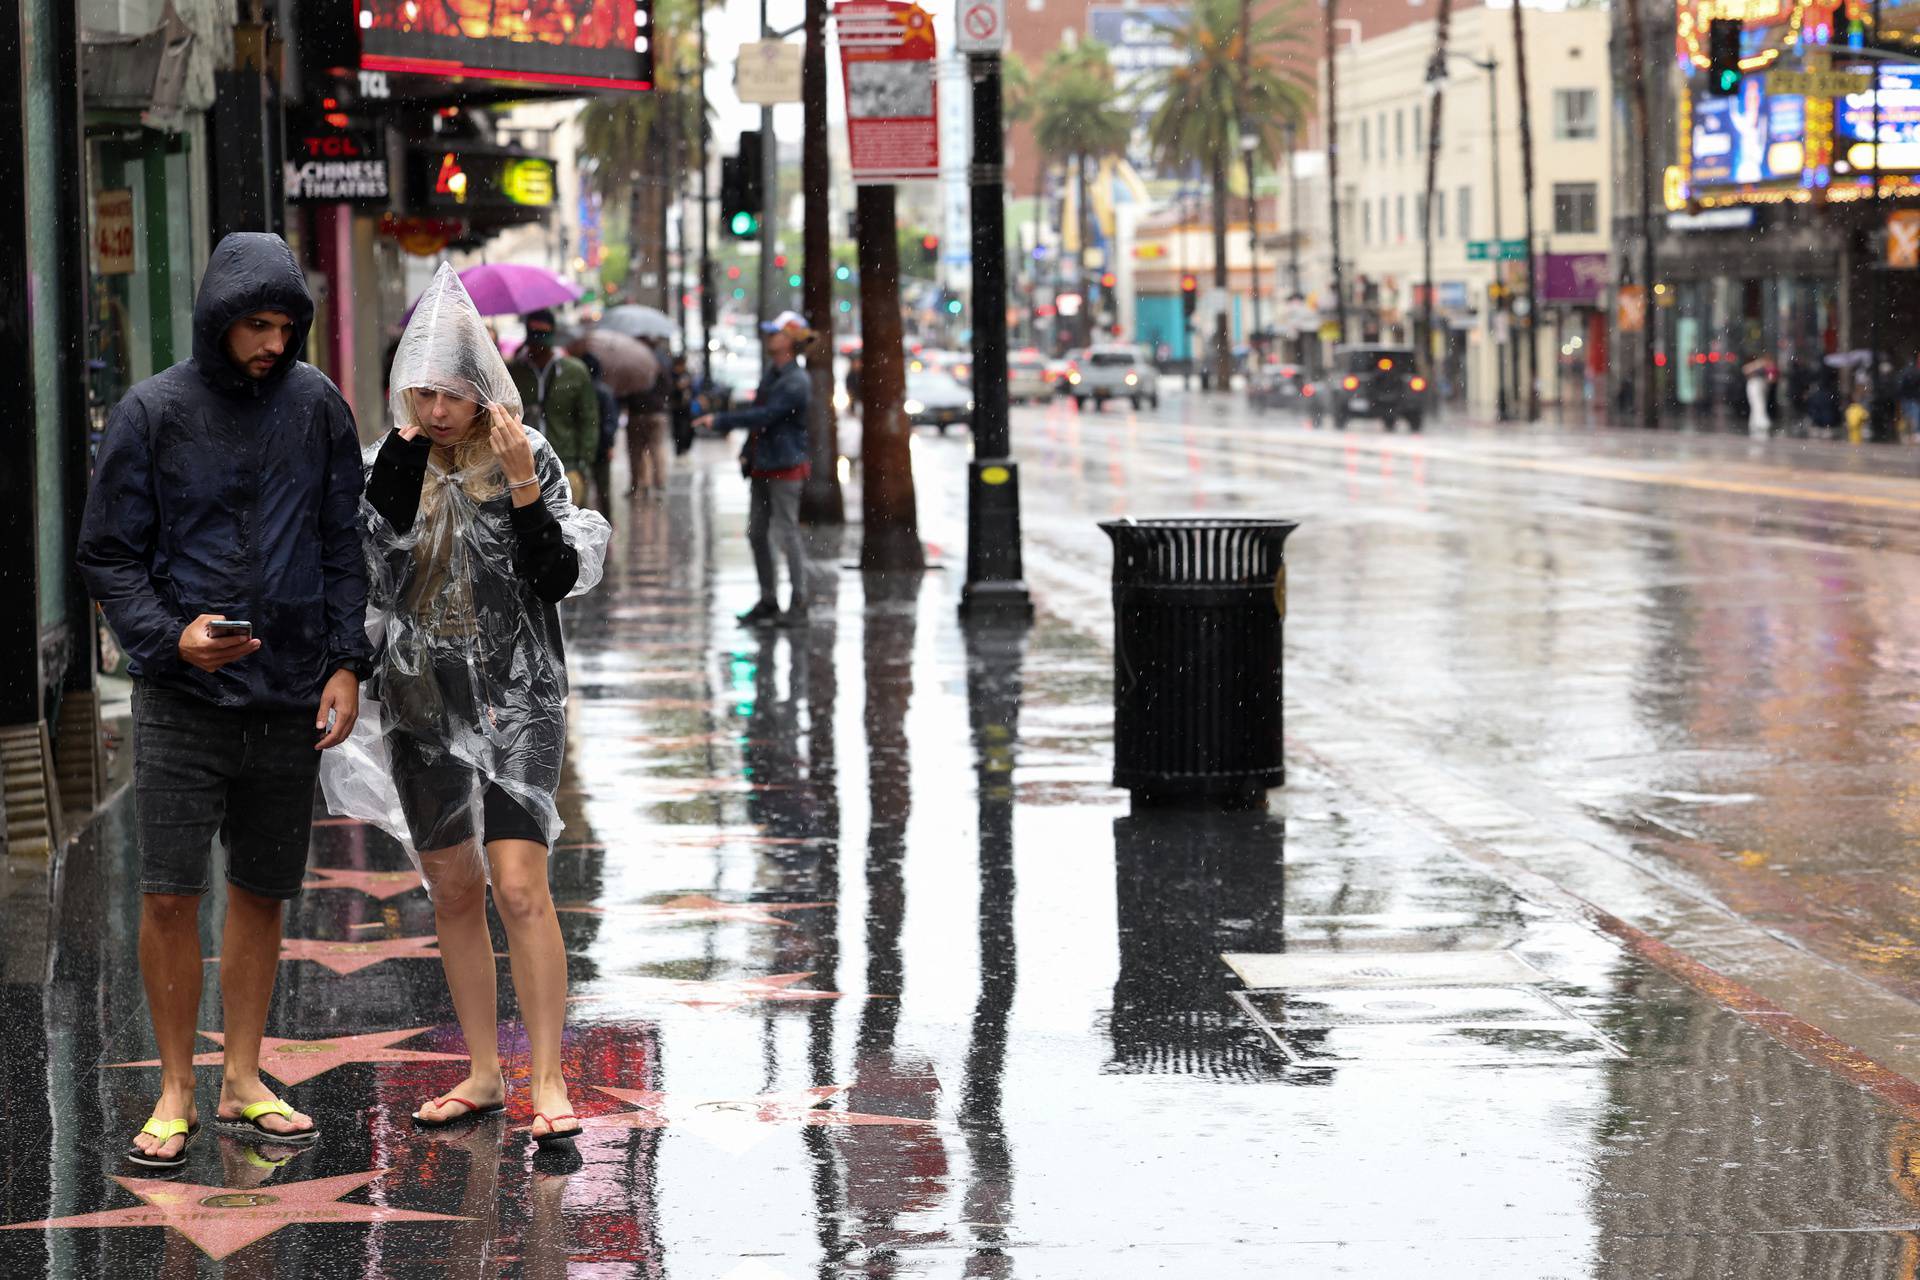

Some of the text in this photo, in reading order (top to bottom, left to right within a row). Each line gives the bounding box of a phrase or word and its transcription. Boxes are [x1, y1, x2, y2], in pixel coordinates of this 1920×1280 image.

[358, 71, 390, 98] TCL
[306, 137, 359, 156] TCL
[302, 160, 386, 180] CHINESE
[304, 180, 388, 198] THEATRES
